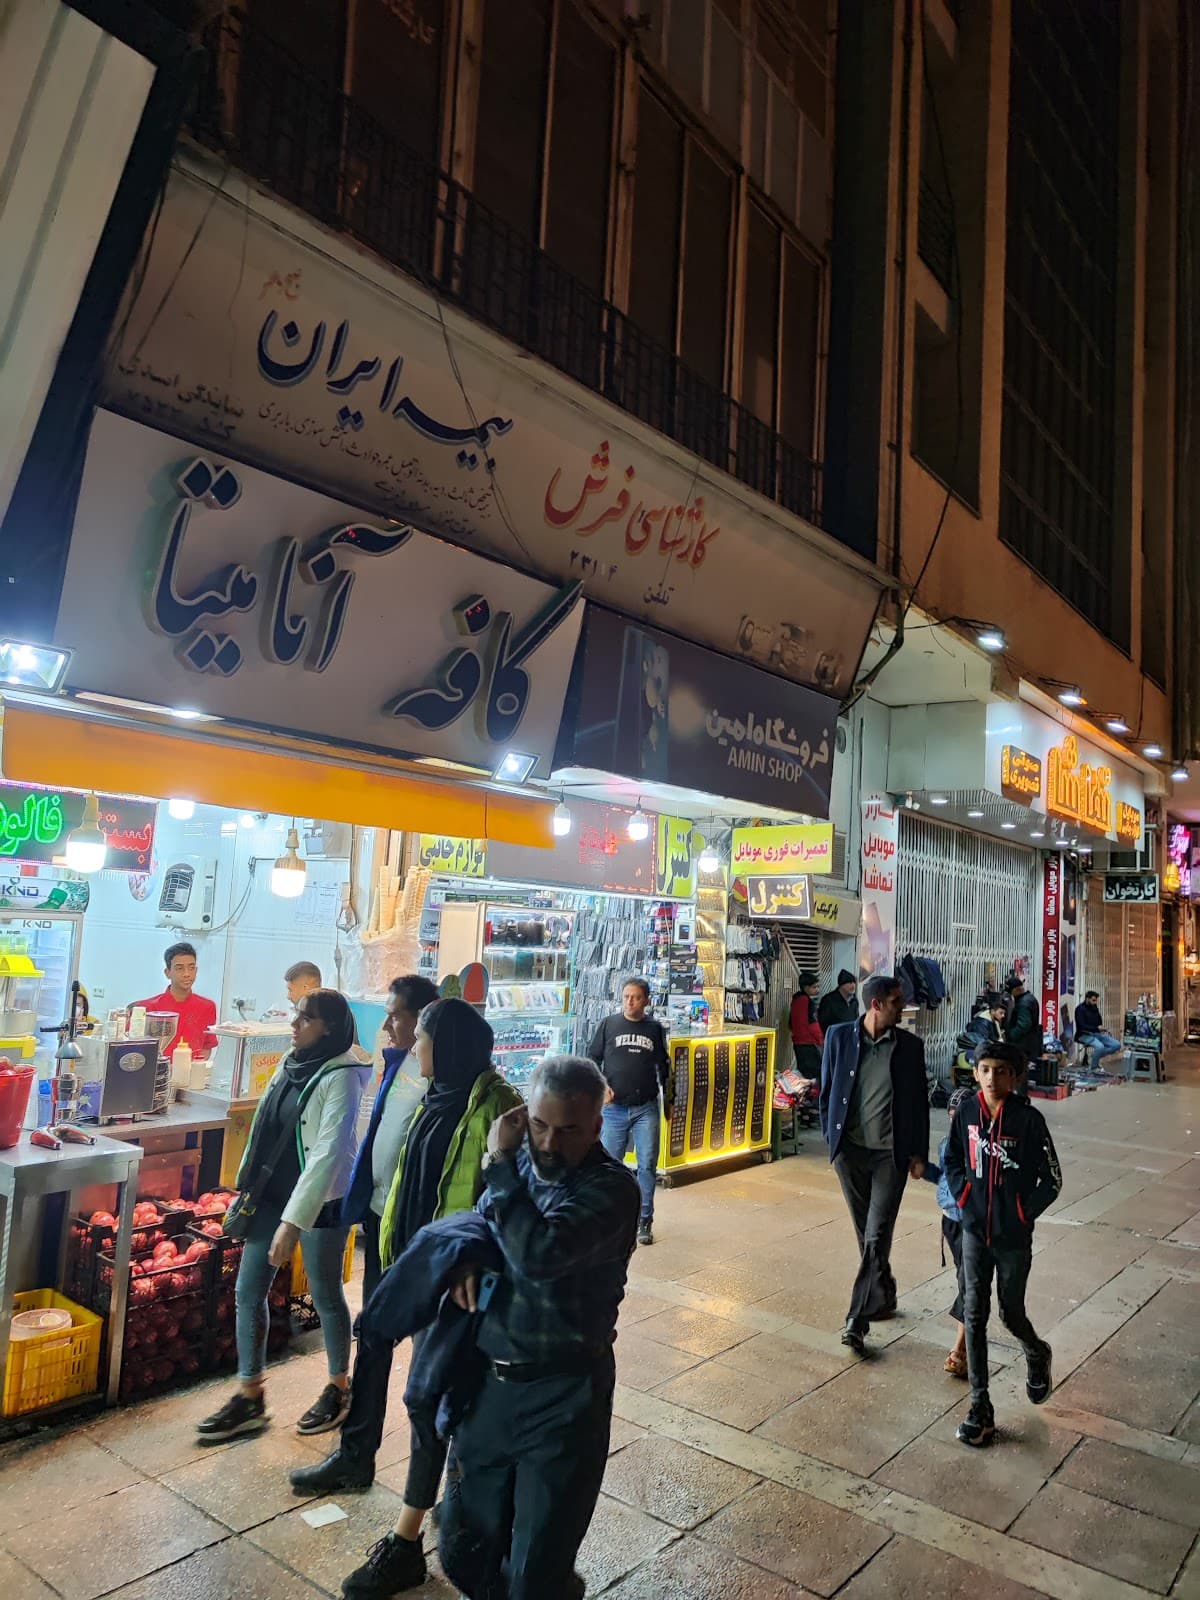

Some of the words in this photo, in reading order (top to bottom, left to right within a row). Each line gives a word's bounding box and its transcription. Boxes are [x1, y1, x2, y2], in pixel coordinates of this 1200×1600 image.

[257, 309, 404, 429] ایران
[393, 396, 514, 473] بیمه
[544, 440, 635, 537] فرش
[624, 497, 720, 568] کارشناسی
[383, 578, 586, 744] کافه
[705, 709, 754, 746] امین
[752, 717, 830, 769] فروشگاه
[727, 746, 766, 775] AMIN
[767, 758, 802, 784] SHOP
[0, 794, 62, 855] فالو
[864, 795, 895, 826] بازار
[733, 841, 762, 864] موبایل
[763, 839, 789, 863] فوری
[791, 838, 829, 862] تعمیرات
[863, 832, 895, 861] موبایل
[864, 864, 894, 892] تماشا
[1105, 883, 1156, 900] کارتخوان
[751, 879, 806, 915] کنترل
[1045, 896, 1056, 916] تماشا
[23, 919, 52, 929] KNO
[1045, 970, 1055, 990] تماشا
[615, 1033, 654, 1051] WELLNESS
